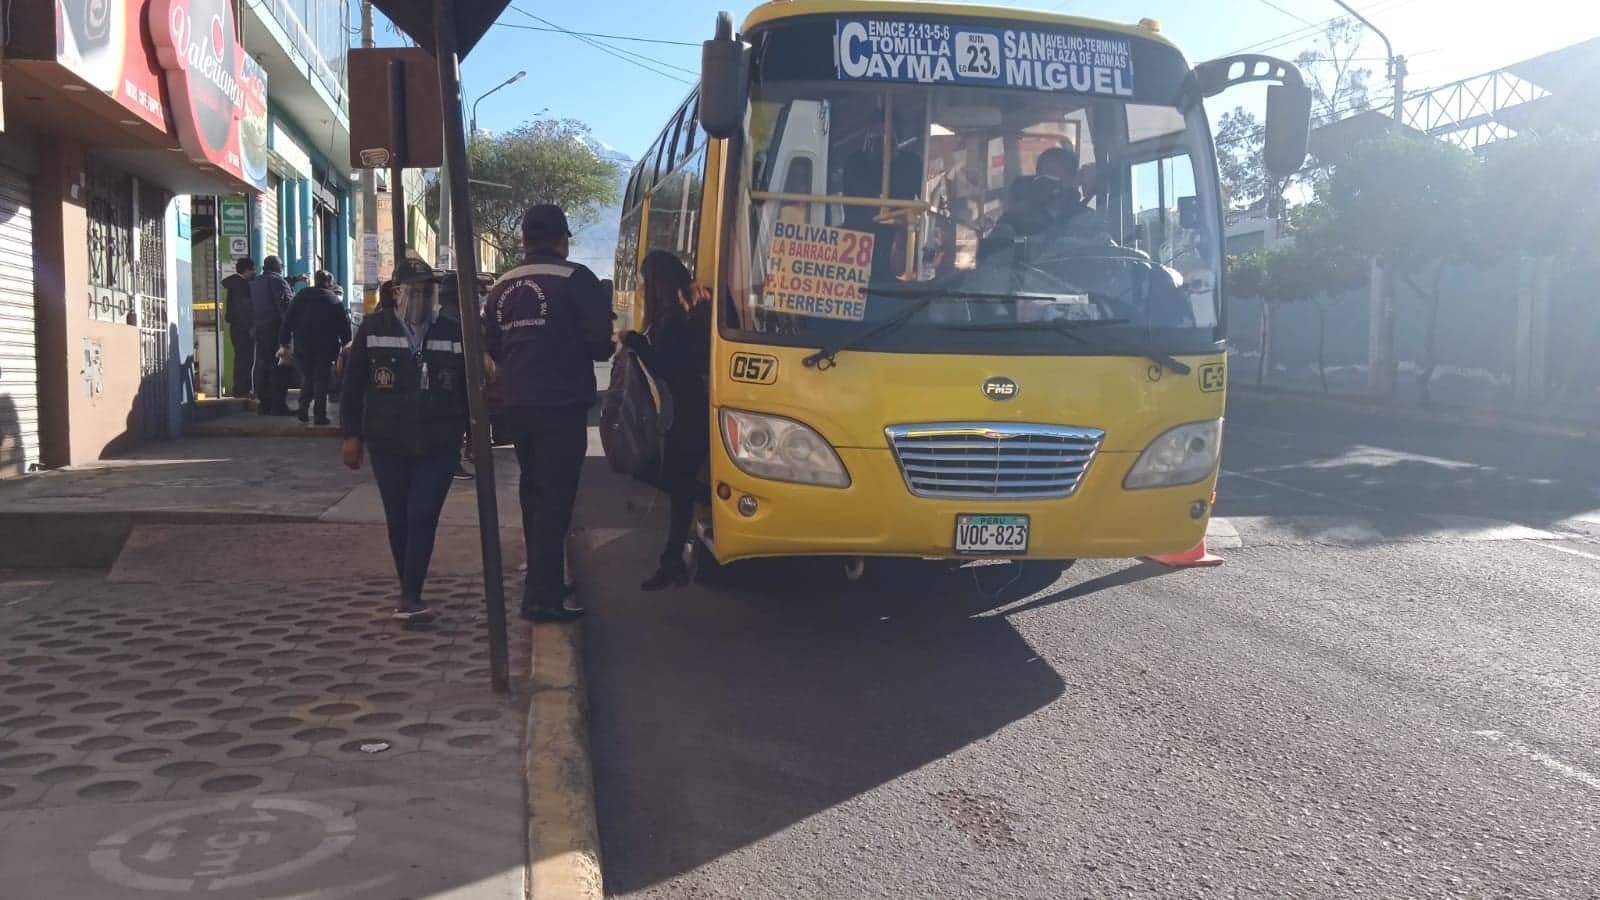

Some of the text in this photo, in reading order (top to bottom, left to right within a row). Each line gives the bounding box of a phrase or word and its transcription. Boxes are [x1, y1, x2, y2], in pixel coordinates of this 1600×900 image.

[1004, 30, 1046, 60] SAN
[967, 45, 992, 73] 23
[1080, 51, 1092, 65] DE
[1094, 53, 1127, 68] ARMAS
[1006, 59, 1133, 96] MIGUEL
[774, 222, 839, 246] BOLIVAR
[772, 239, 838, 263] LA BARRACA
[839, 232, 873, 267] 28
[791, 260, 867, 284] GENERAL
[816, 279, 867, 300] INCAS
[777, 292, 864, 318] TERRESTRE
[733, 356, 775, 380] 057
[960, 525, 1025, 546] VOC-823
